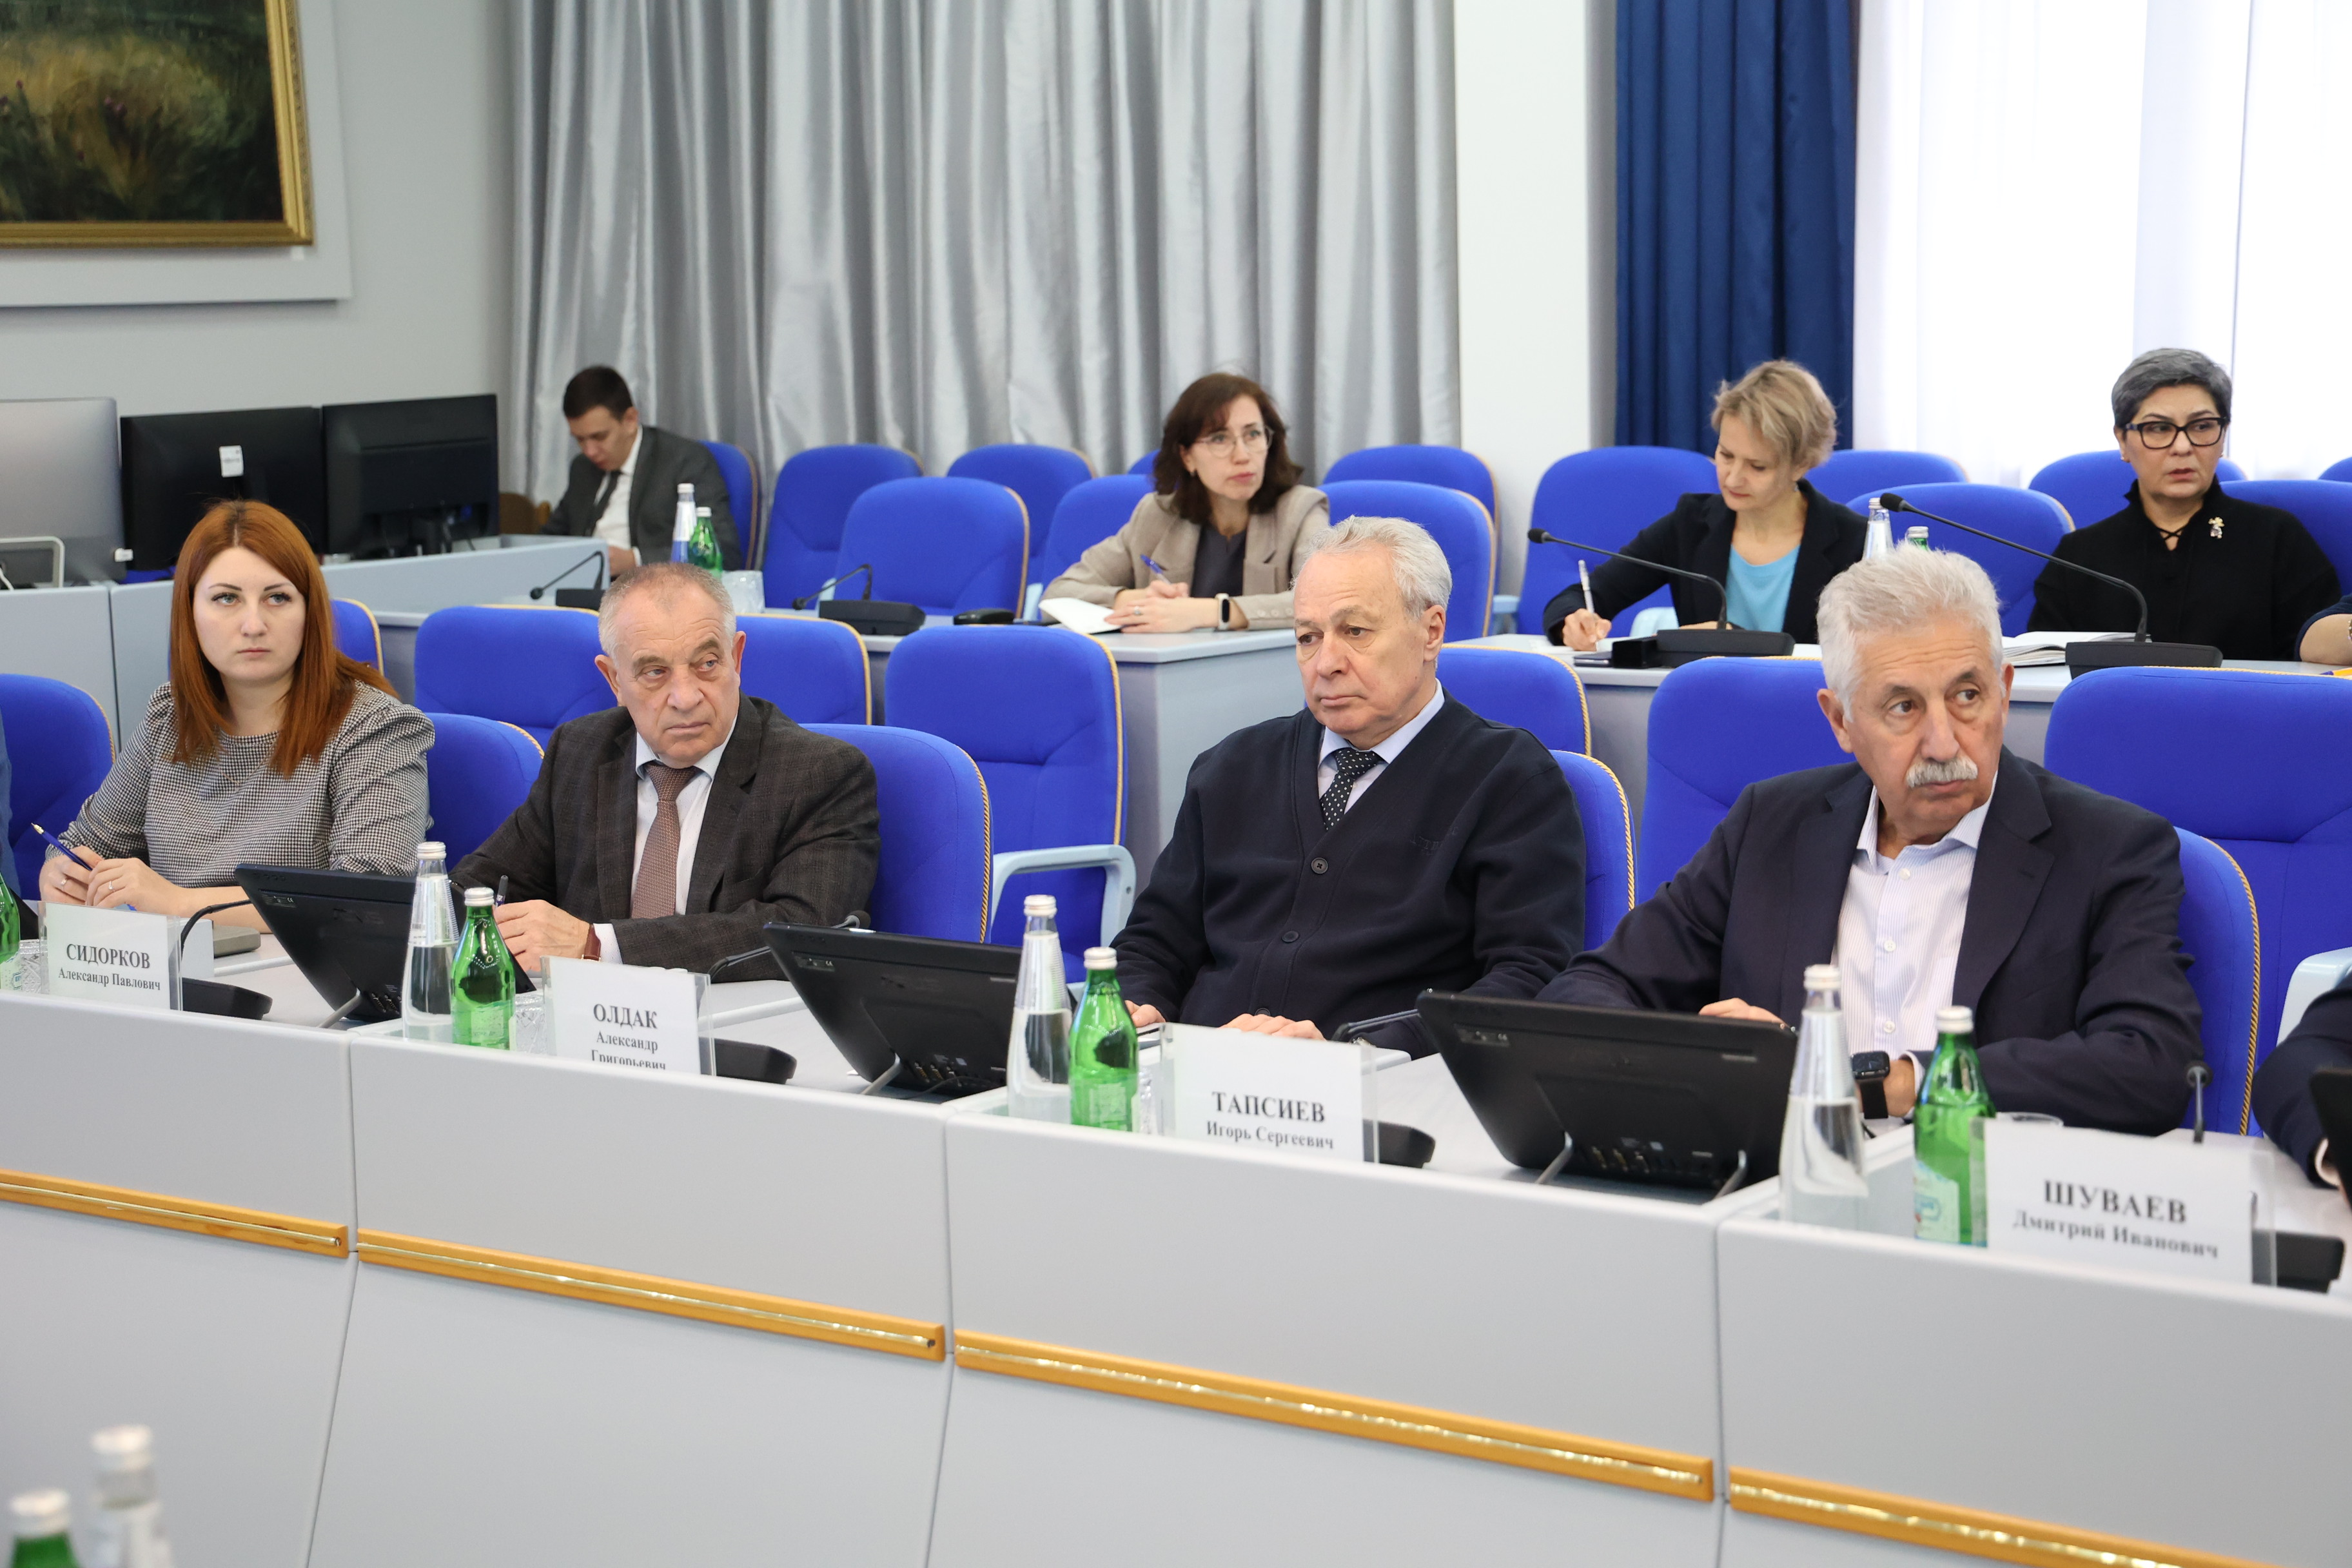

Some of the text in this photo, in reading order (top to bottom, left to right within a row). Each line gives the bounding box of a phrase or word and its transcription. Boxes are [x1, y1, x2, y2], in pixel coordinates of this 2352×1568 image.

[66, 943, 150, 969] СИДОРКОВ
[59, 967, 161, 990] Александр Павлович
[593, 1003, 658, 1030] ОЛДАК
[596, 1030, 658, 1054] Александр
[1211, 1091, 1325, 1122] ТАПСИЕВ
[1207, 1120, 1333, 1149] Игорь Сергеевич
[2044, 1179, 2186, 1224] ШУВАЕВ
[2013, 1210, 2218, 1259] Дмитрий Иванович
